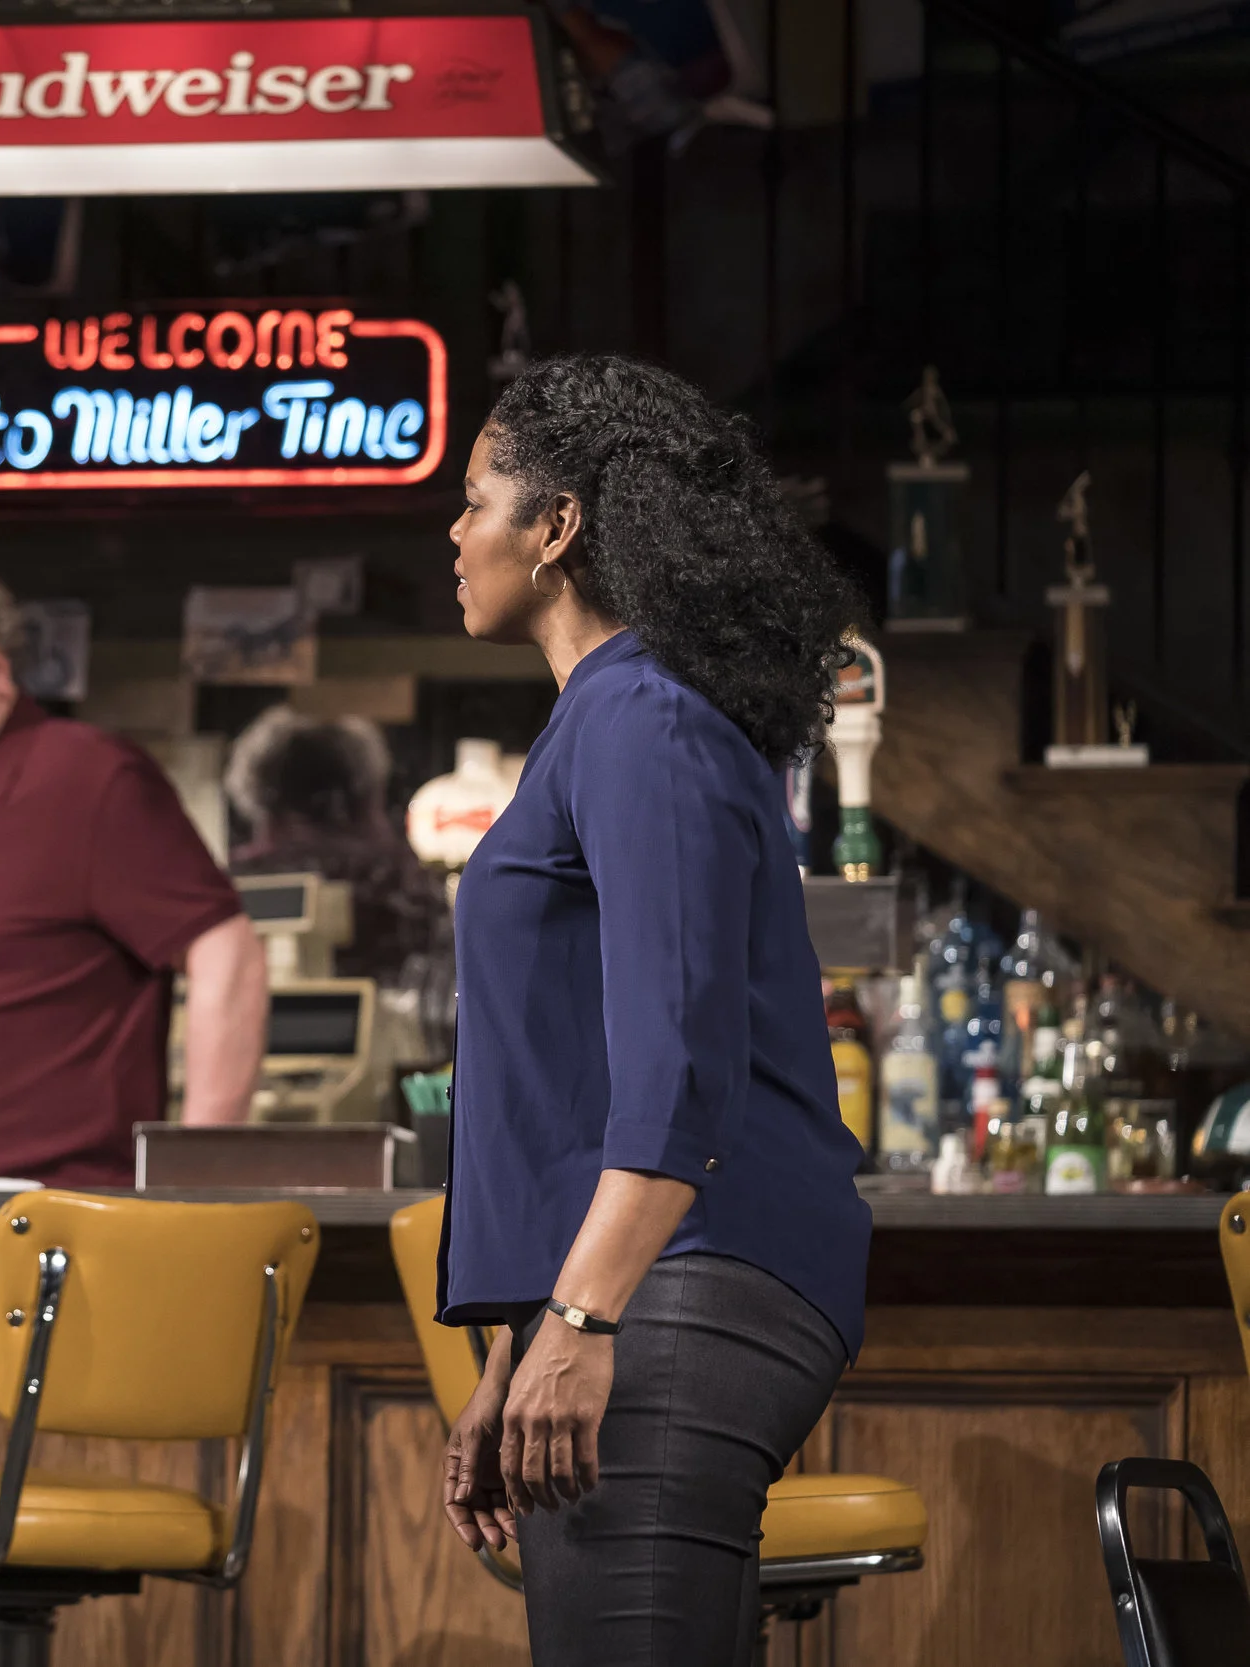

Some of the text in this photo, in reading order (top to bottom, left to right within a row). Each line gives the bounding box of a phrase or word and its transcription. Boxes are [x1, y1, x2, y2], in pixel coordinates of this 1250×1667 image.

[42, 309, 355, 371] WELCOME
[52, 384, 261, 466] Miller
[262, 379, 425, 460] Time
